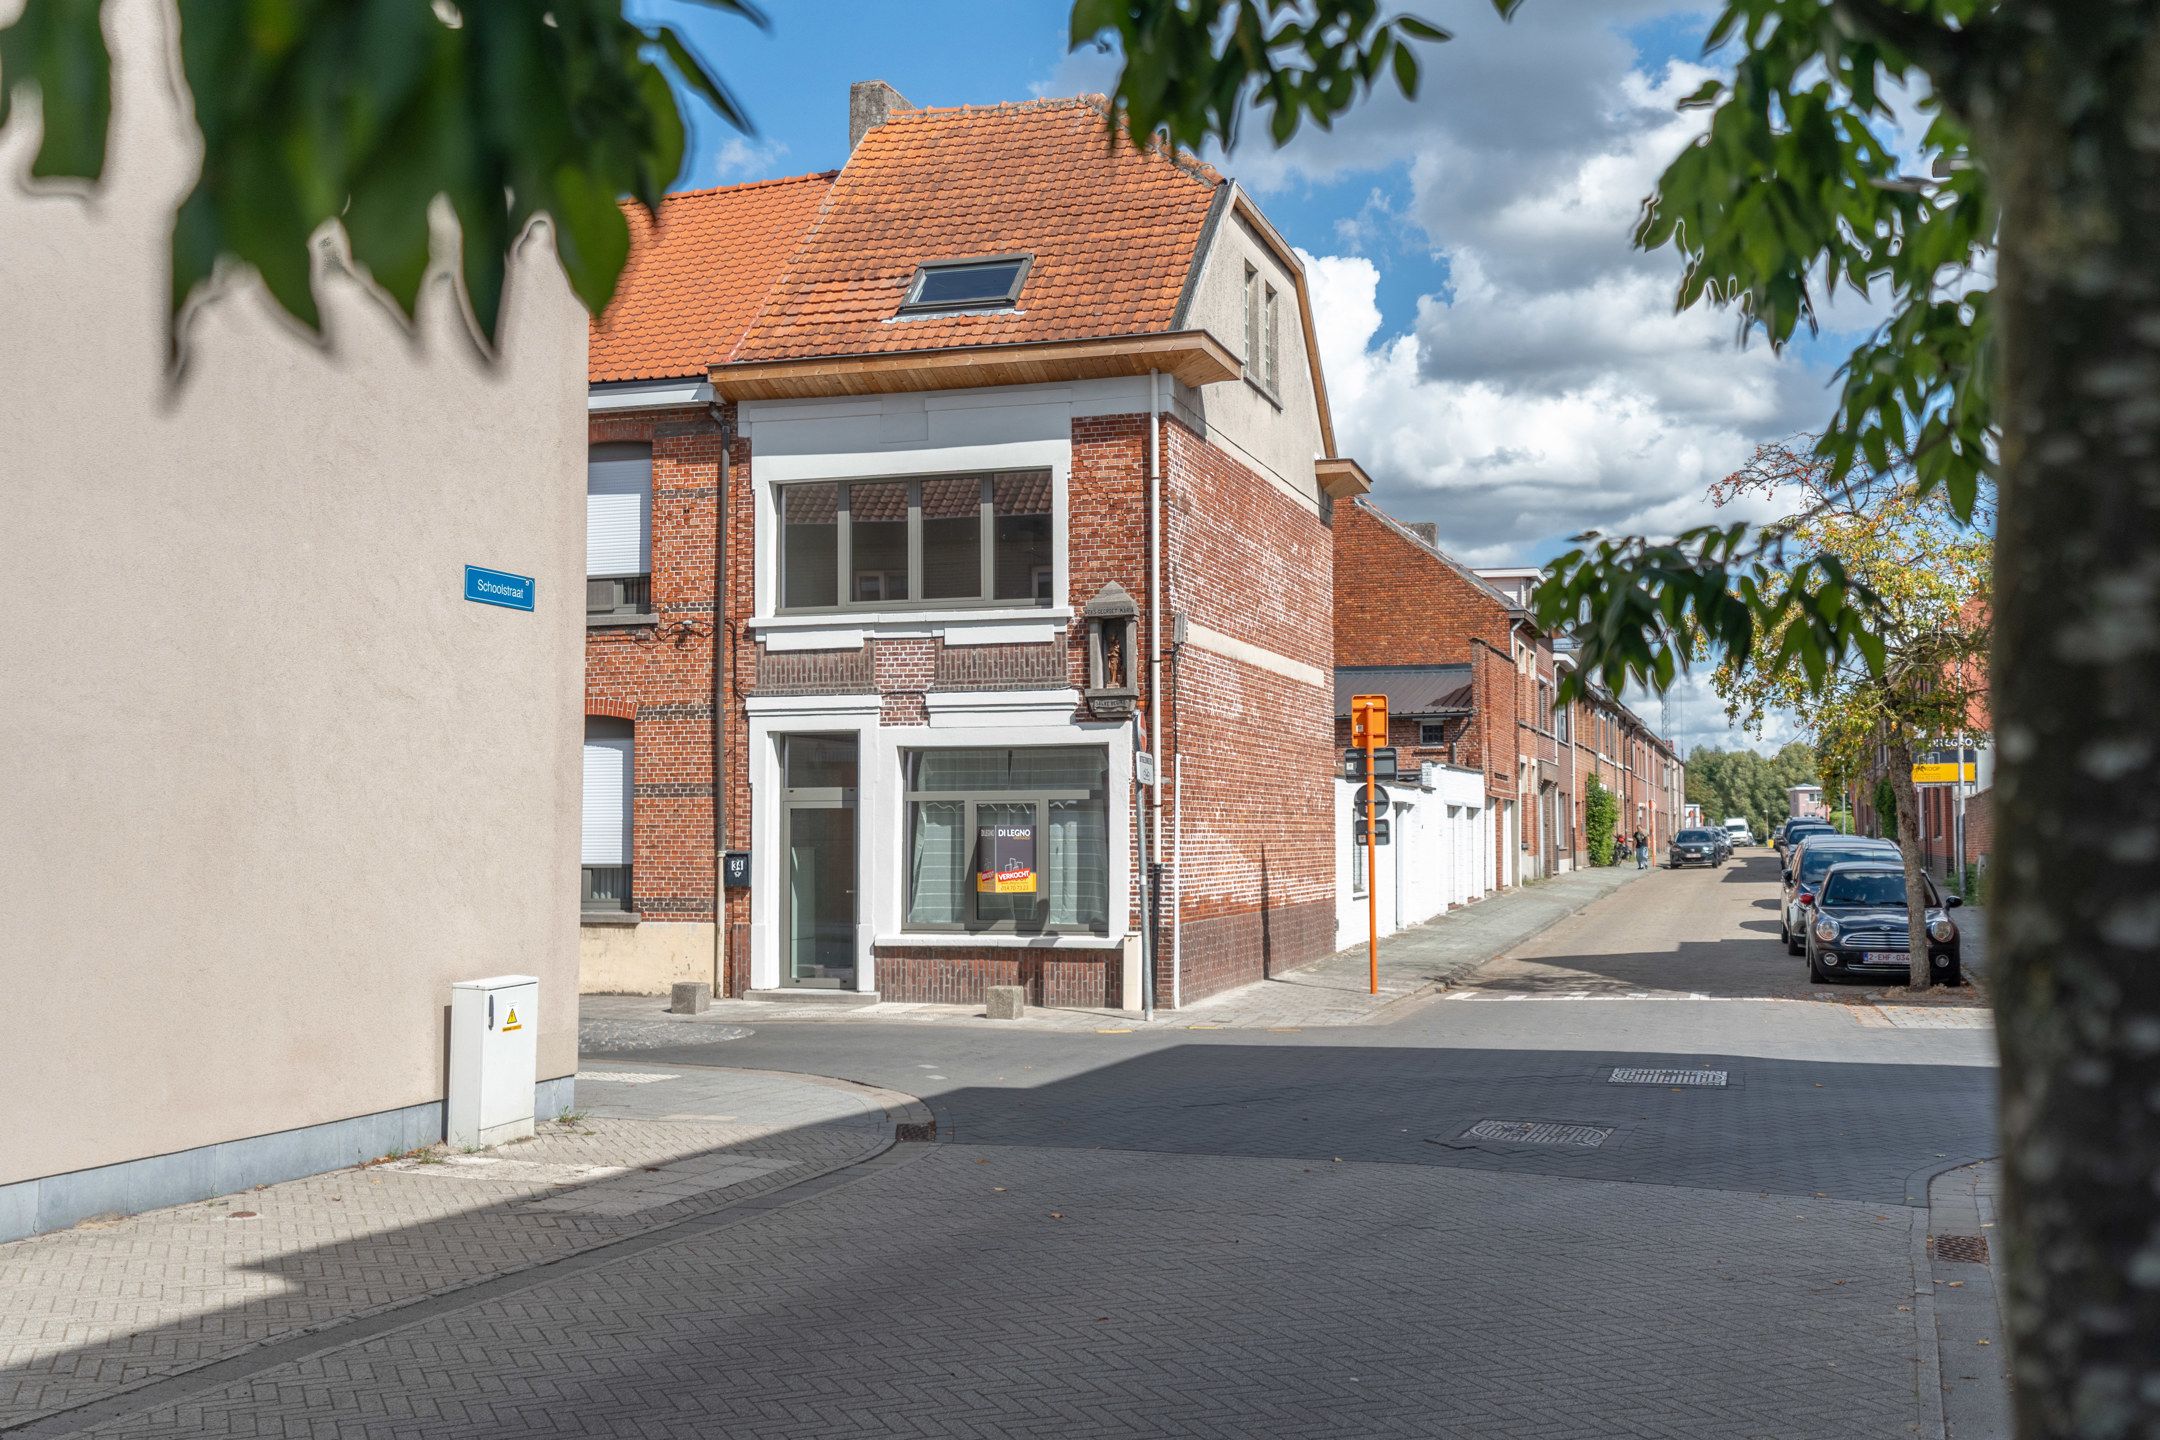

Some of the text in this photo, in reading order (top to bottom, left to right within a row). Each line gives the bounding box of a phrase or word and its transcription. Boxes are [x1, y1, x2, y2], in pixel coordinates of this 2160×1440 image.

[477, 579, 524, 599] Schoolstraat
[998, 829, 1031, 837] DI LEGNO
[998, 870, 1029, 881] VERKOCHT
